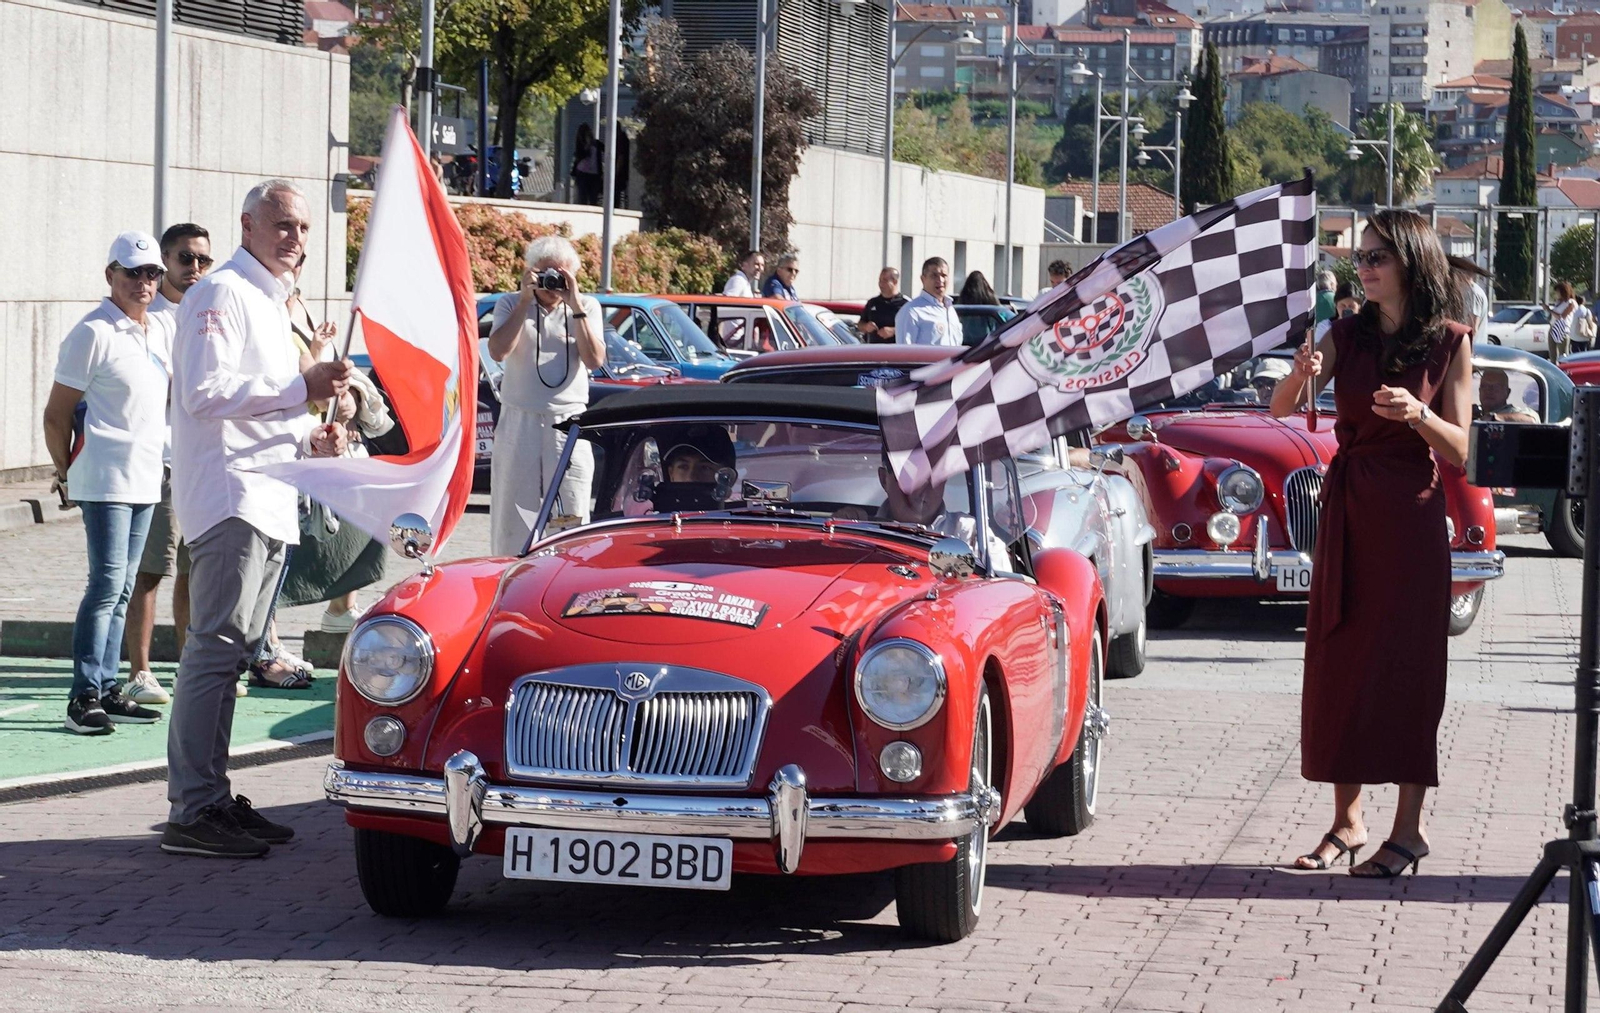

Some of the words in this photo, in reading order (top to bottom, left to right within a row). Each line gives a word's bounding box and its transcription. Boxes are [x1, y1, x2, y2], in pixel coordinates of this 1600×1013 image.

[479, 441, 487, 451] 8
[1283, 568, 1295, 588] H
[1299, 569, 1311, 588] 0
[687, 600, 718, 613] XVIII
[720, 605, 760, 619] RALLY
[718, 593, 755, 609] LANZAL
[669, 606, 711, 618] CIUDAD
[711, 611, 728, 621] DE
[729, 614, 757, 626] VIGO
[626, 673, 646, 689] MG
[510, 834, 533, 872] H
[550, 837, 641, 879] 1902
[651, 842, 724, 882] BBD
